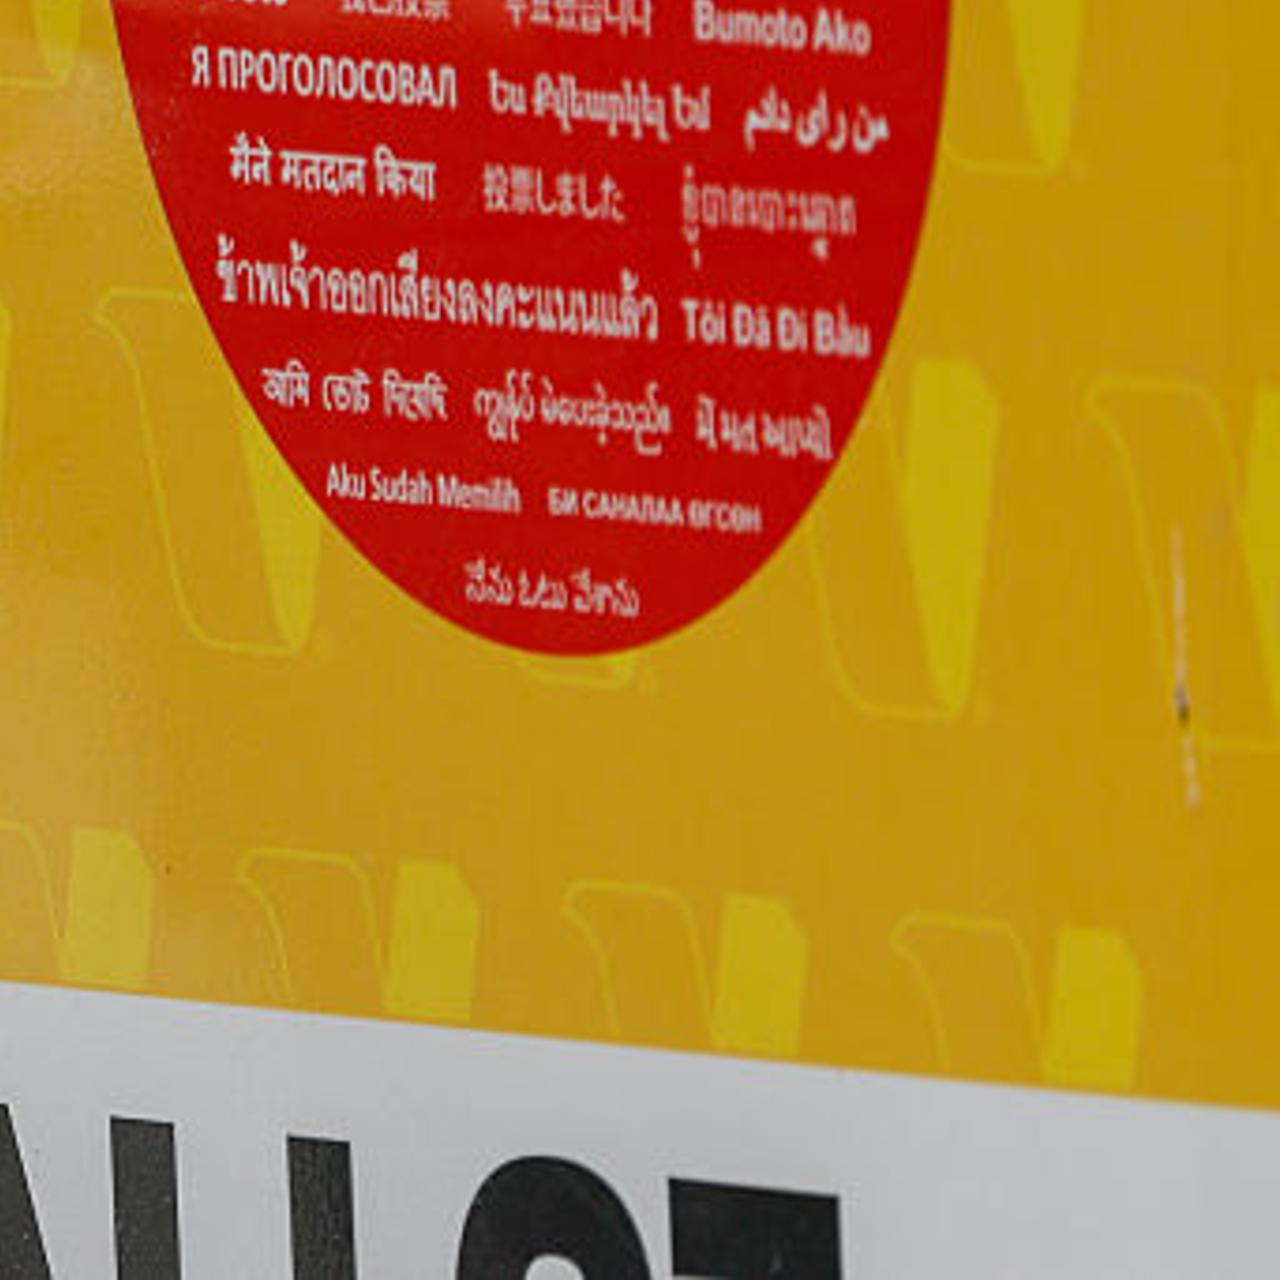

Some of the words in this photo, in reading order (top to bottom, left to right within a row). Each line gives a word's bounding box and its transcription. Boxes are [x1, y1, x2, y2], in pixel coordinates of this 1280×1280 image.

[813, 8, 871, 55] Ako
[191, 44, 211, 88] Я
[217, 46, 457, 109] ПРОГОЛОСОВАЛ
[373, 143, 437, 201] किया
[326, 463, 366, 500] Aku
[369, 467, 433, 505] Sudah
[548, 487, 579, 516] БИ
